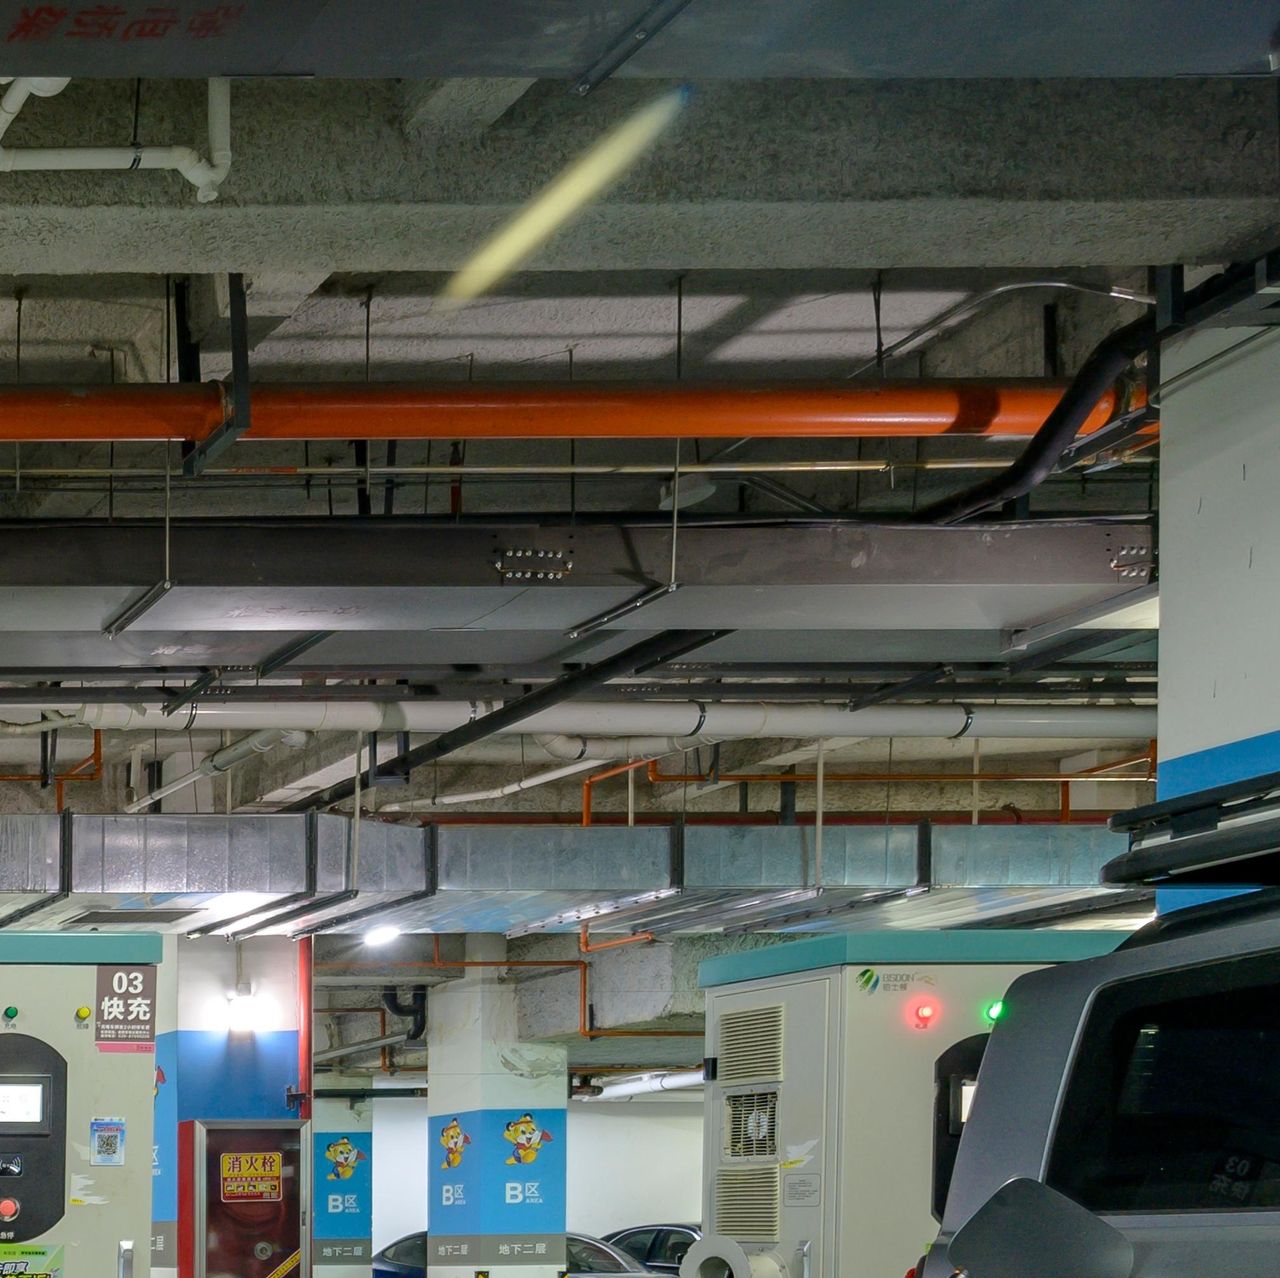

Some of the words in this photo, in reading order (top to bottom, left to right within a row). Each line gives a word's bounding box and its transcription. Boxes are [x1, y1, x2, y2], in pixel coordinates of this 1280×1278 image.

[113, 972, 143, 993] 03
[101, 996, 150, 1020] 快充
[227, 1155, 276, 1172] 消火栓
[505, 1182, 539, 1204] B区
[328, 1194, 357, 1213] B区
[323, 1246, 363, 1257] 地下二层
[438, 1244, 468, 1255] 地下二层
[499, 1243, 547, 1255] 地下二层
